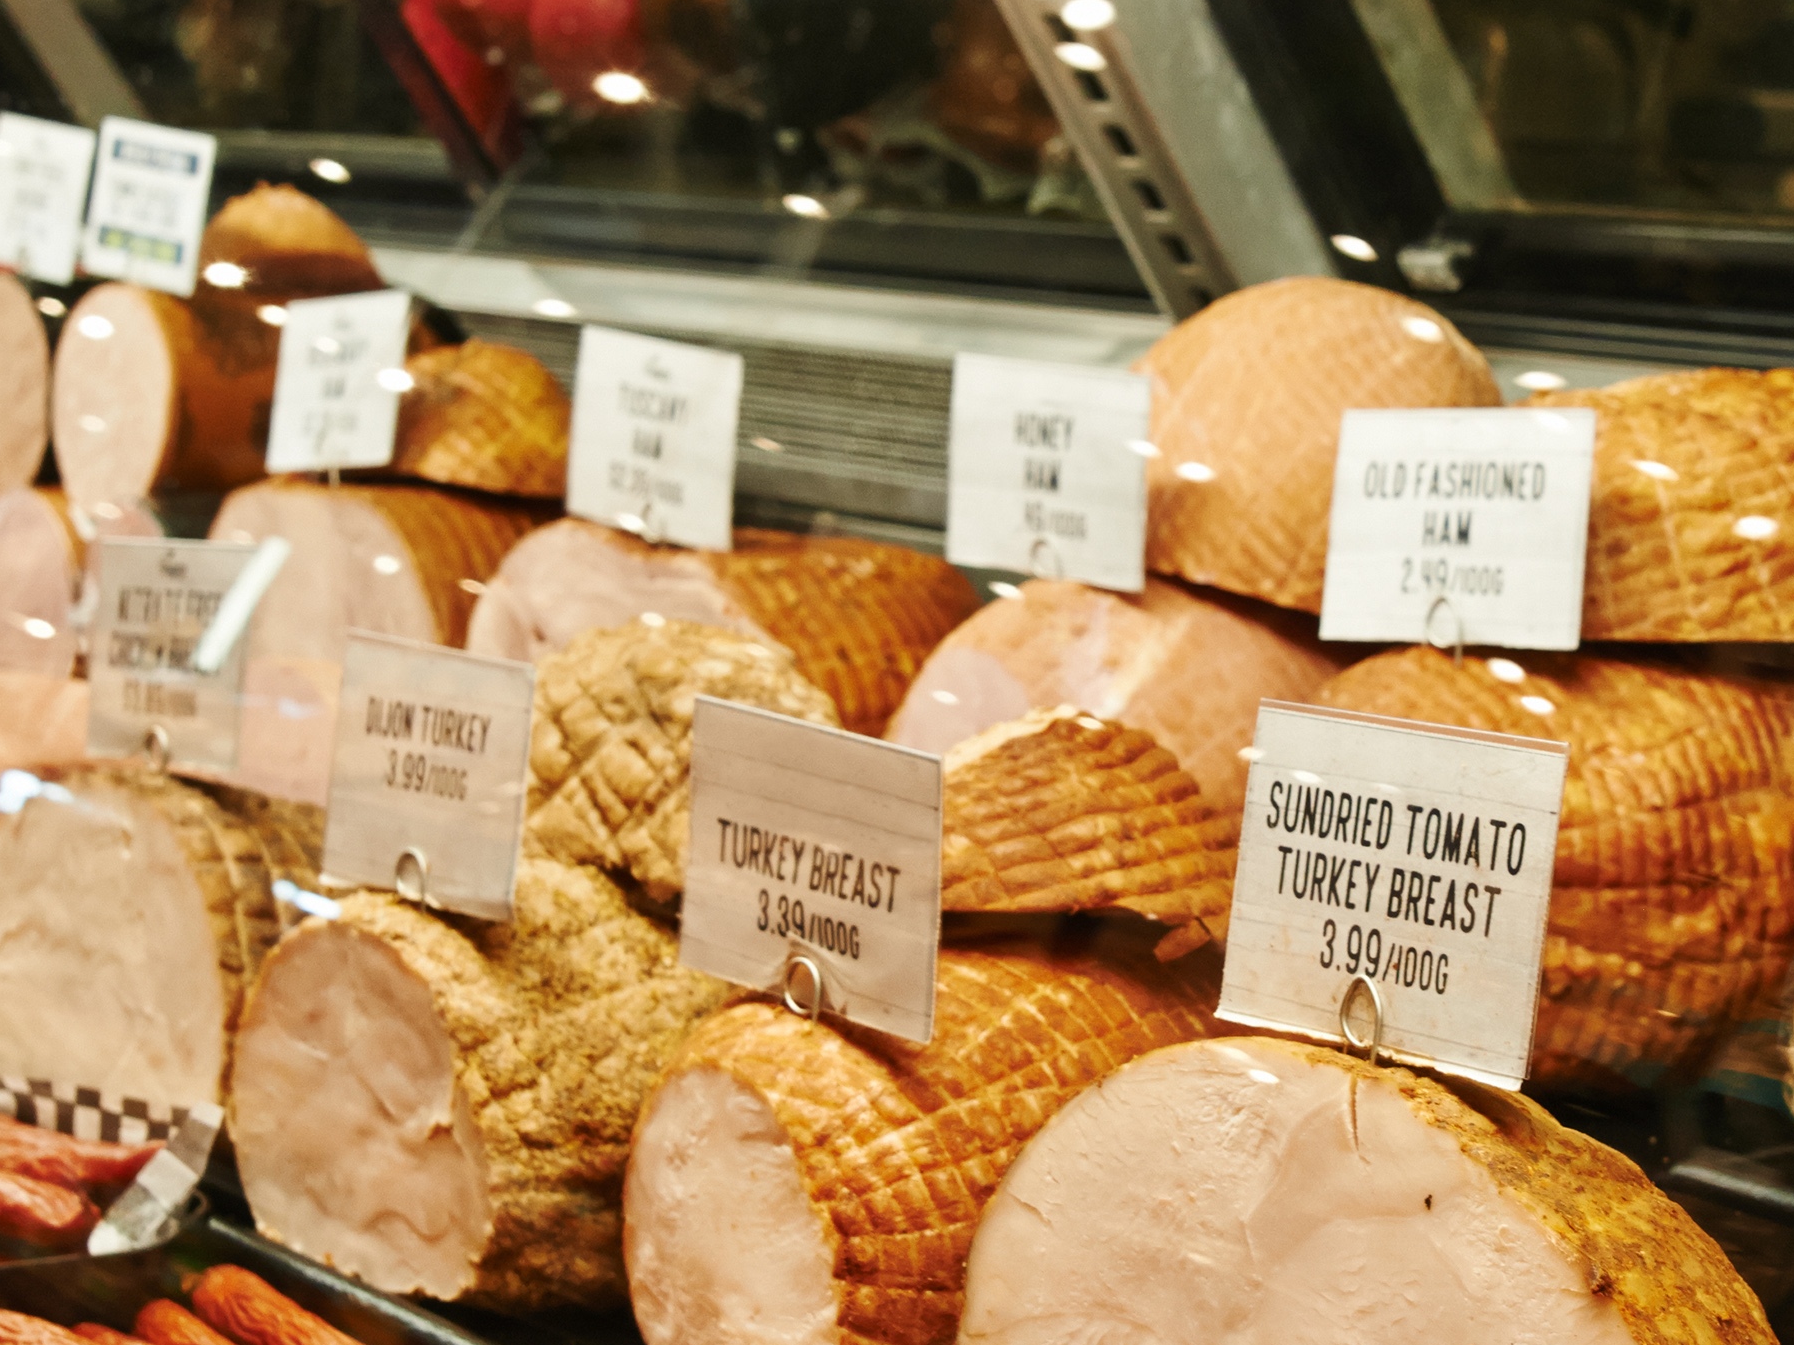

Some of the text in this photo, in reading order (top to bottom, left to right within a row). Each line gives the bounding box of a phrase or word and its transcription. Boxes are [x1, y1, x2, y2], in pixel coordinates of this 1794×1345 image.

[1364, 461, 1546, 501] OLD FASHIONED
[1422, 511, 1471, 546] HAM
[422, 705, 491, 753] TURKEY
[717, 818, 901, 913] TURKEY BREAST
[1267, 780, 1526, 876] SUNDRIED TOMATO
[1278, 846, 1501, 938] TURKEY BREAST
[1320, 919, 1449, 995] 3.99/100G
